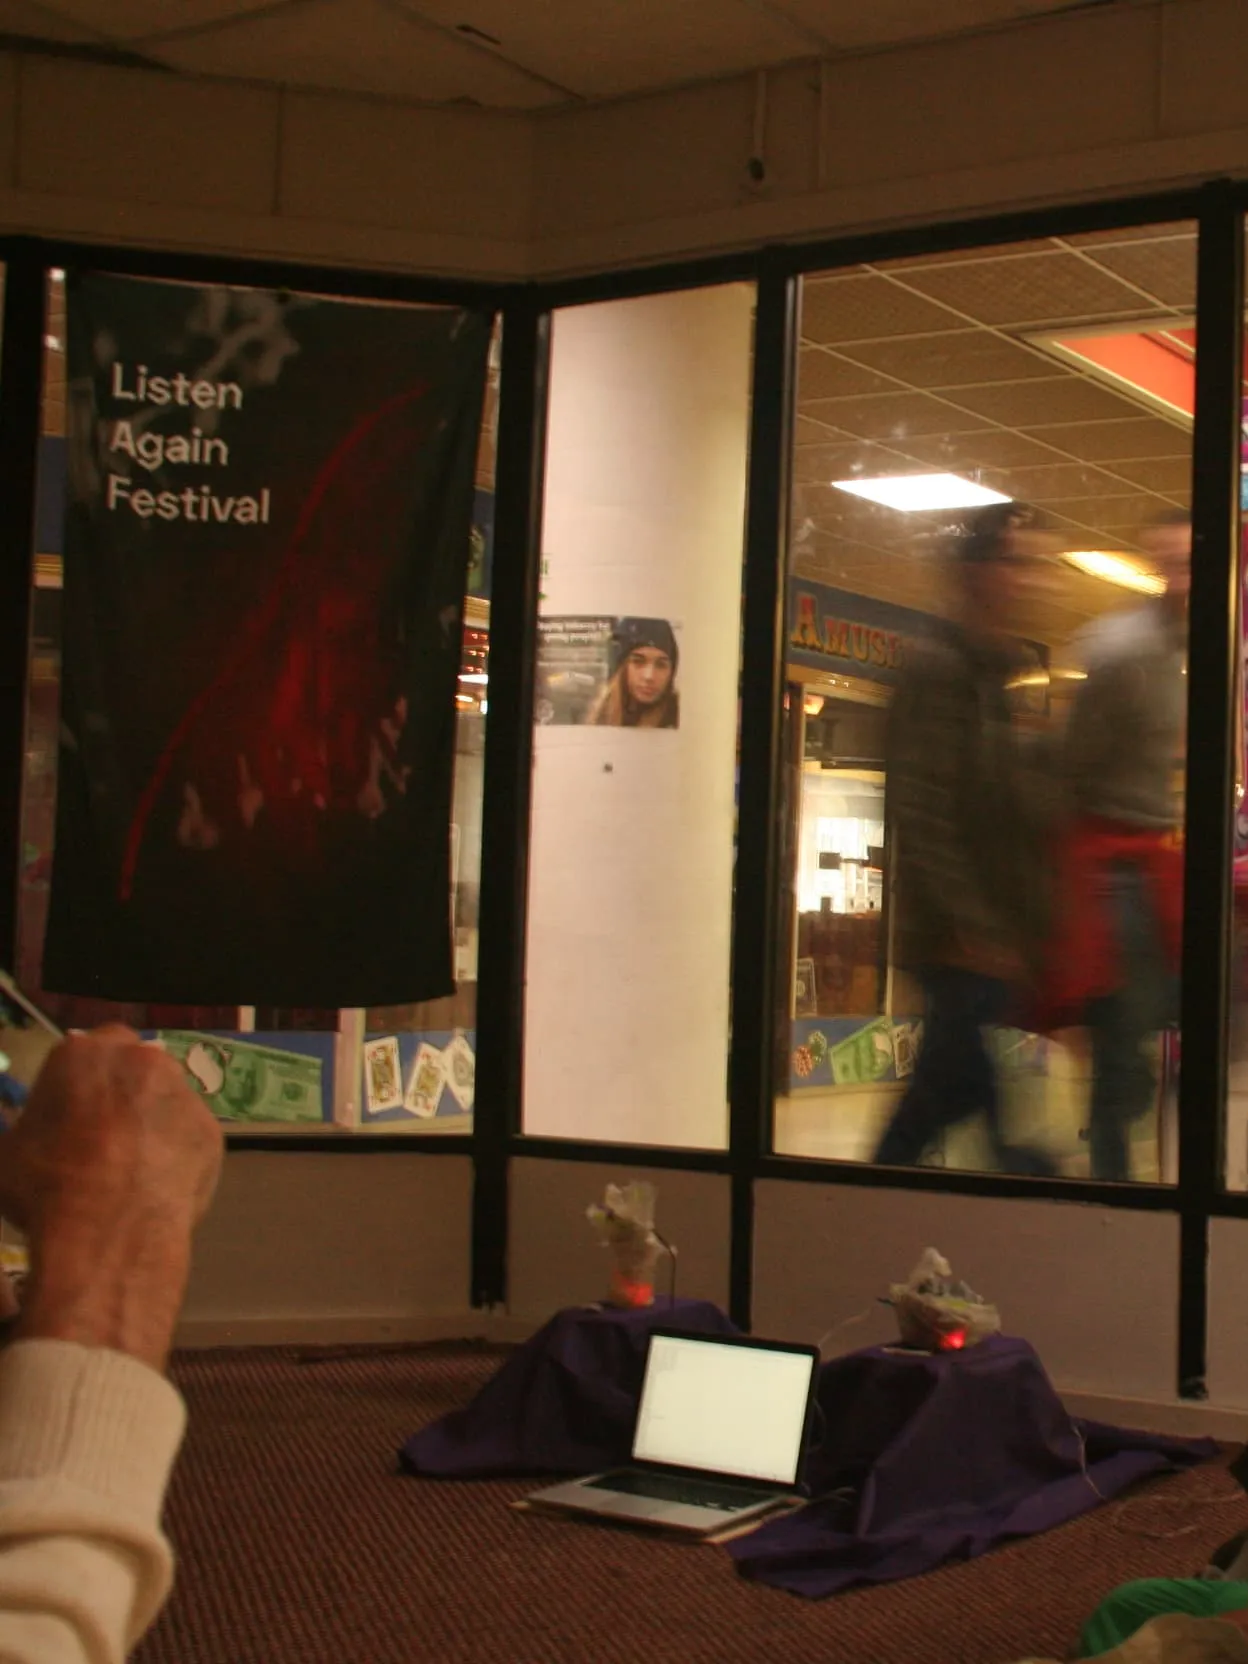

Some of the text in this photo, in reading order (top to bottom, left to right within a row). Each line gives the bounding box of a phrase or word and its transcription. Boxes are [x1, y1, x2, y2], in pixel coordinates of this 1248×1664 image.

[112, 361, 243, 411] Listen
[110, 420, 229, 471] Again
[107, 473, 271, 524] Festival
